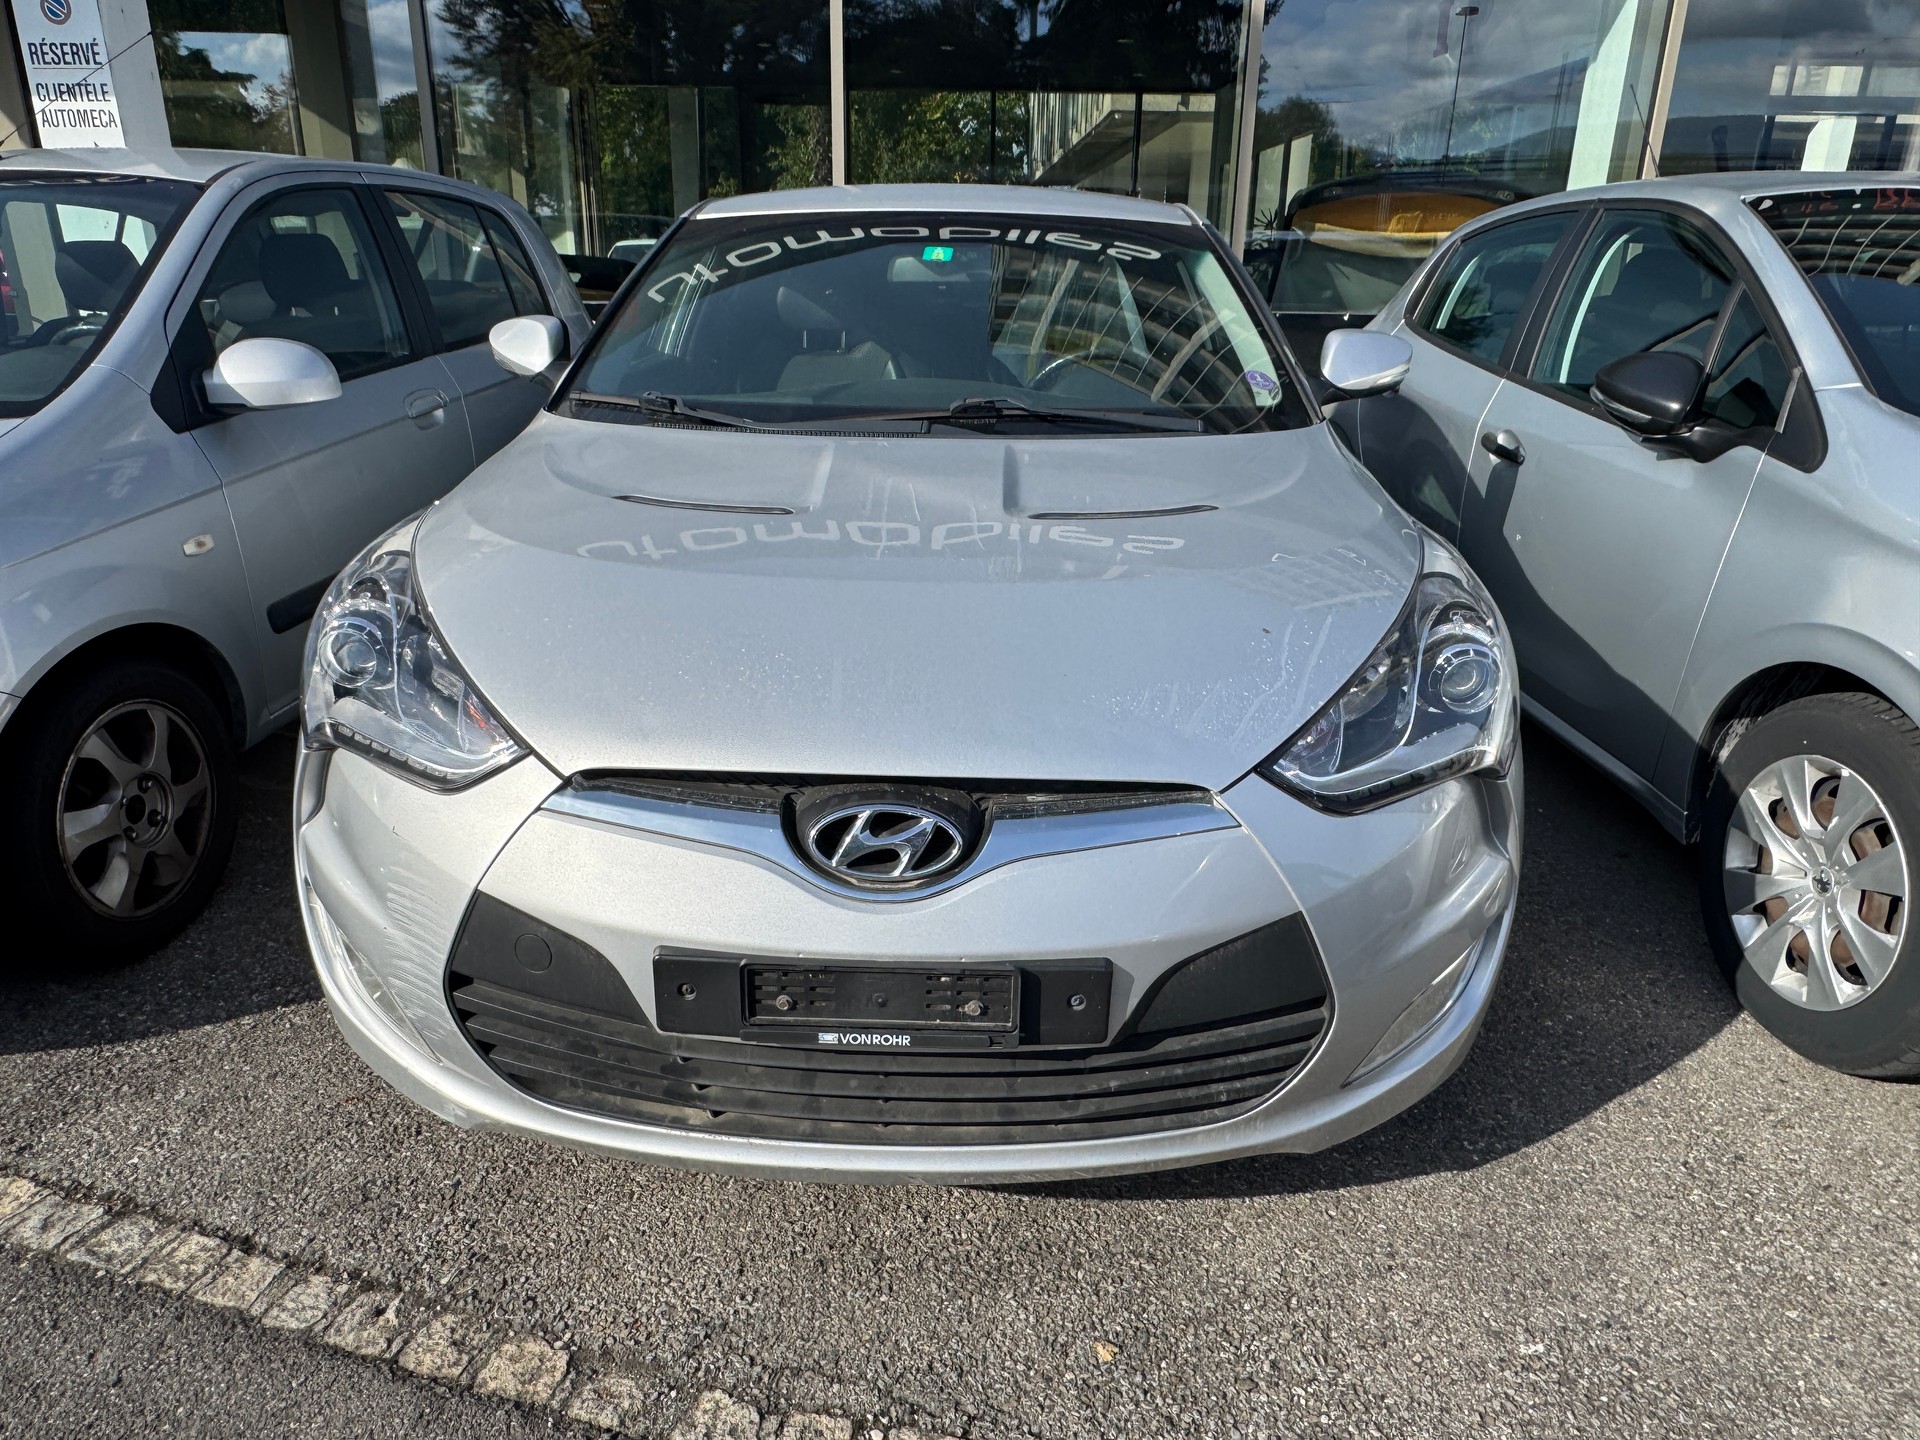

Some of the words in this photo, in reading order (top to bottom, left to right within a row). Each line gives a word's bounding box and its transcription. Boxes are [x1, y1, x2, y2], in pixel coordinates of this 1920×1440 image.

[27, 38, 103, 66] RÉSERVÉ
[36, 80, 111, 102] CLIENTÈLE
[42, 109, 118, 128] AUTOMECA
